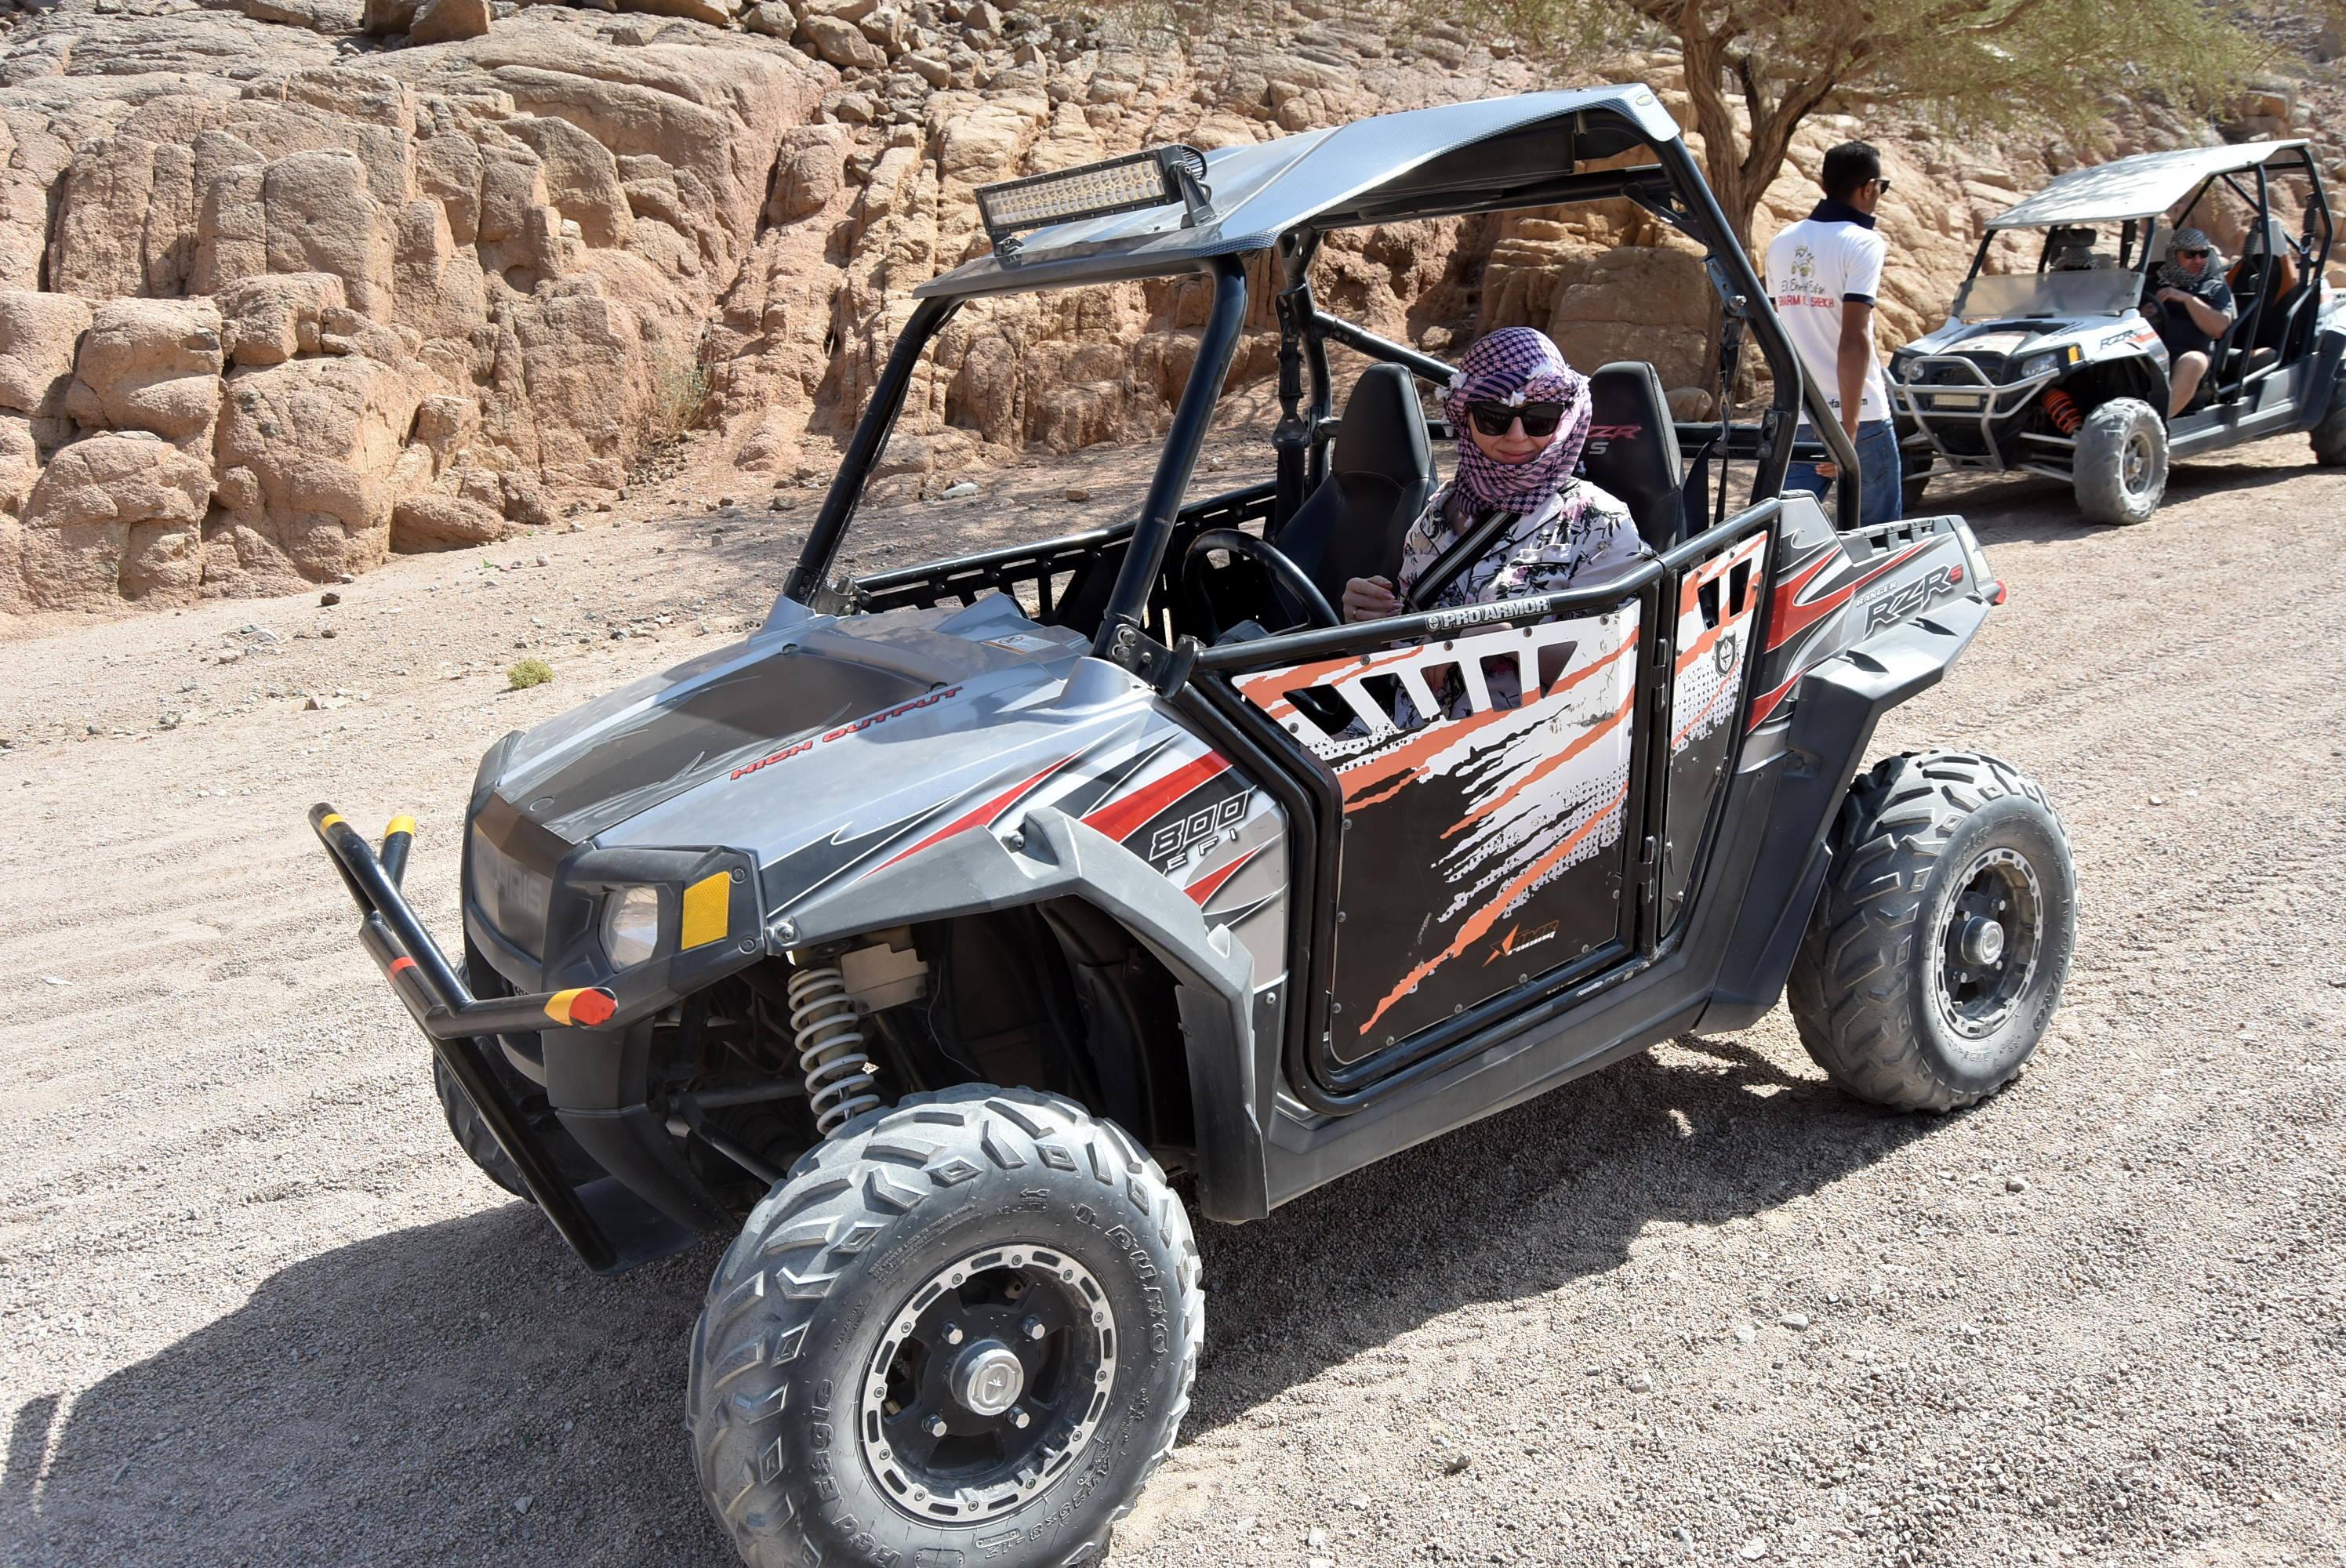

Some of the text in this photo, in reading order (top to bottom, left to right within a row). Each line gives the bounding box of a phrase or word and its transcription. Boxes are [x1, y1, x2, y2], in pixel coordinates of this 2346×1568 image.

[1585, 425, 1642, 440] ZR
[1855, 581, 1897, 608] RANGER
[1443, 598, 1549, 628] PRO ARMOR
[730, 685, 963, 781] HIGH OUTPUT
[1148, 789, 1250, 862] 800
